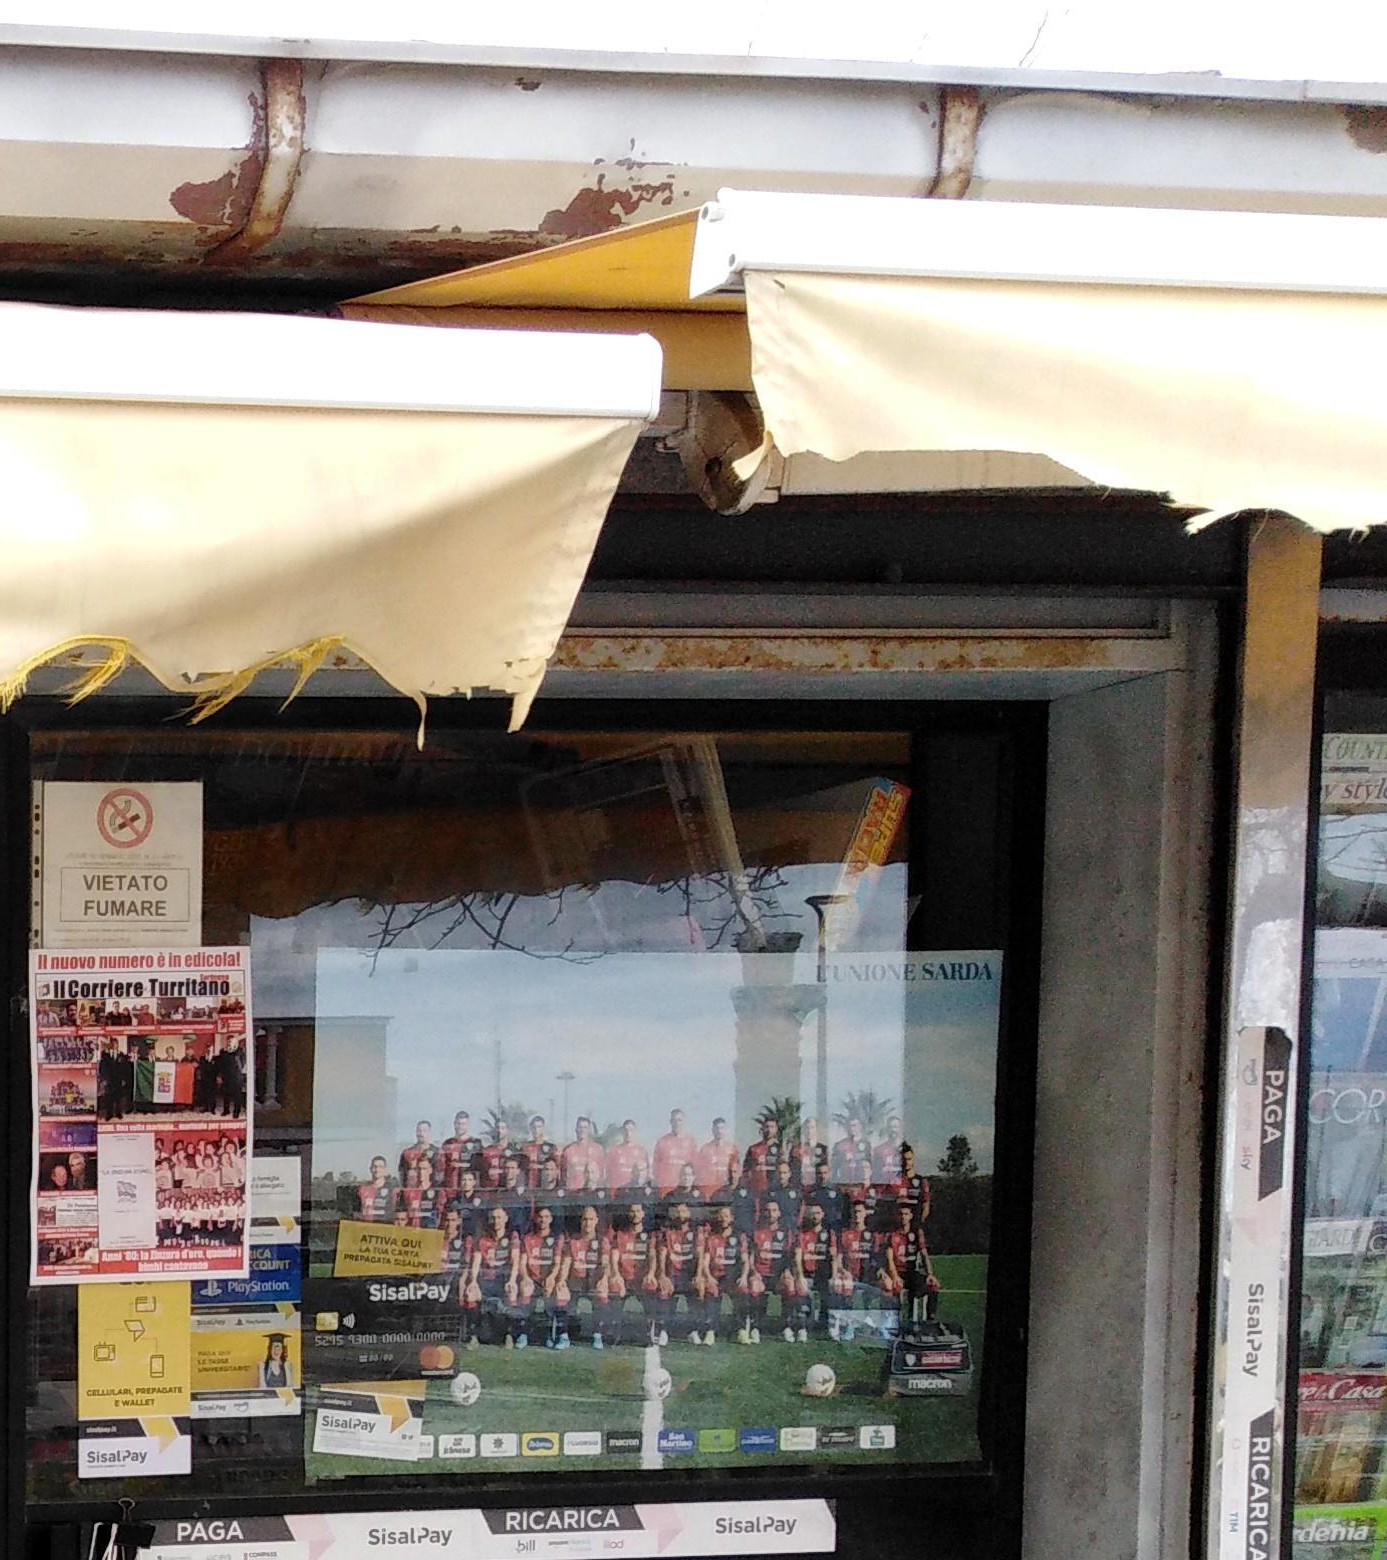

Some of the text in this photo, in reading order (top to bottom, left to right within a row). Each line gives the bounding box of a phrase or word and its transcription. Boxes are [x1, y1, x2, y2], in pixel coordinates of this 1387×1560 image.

[83, 874, 168, 892] VIETATO
[83, 900, 167, 917] FUMARE
[50, 955, 96, 970] nuovo
[99, 953, 154, 969] numero
[168, 953, 182, 968] in
[184, 951, 241, 968] edicola!
[921, 961, 993, 983] SARDA
[68, 979, 144, 998] Corriere
[149, 977, 230, 998] Turritano
[1264, 1069, 1284, 1145] PAGA
[359, 1233, 422, 1250] ATTIVA QUI
[227, 1279, 290, 1296] PlayStation
[369, 1282, 451, 1303] SisalPay
[1241, 1282, 1266, 1379] SisalPay
[135, 1386, 183, 1396] PREPAGATE
[121, 1398, 156, 1407] WALLET
[320, 1415, 377, 1434] SisalPay
[86, 1450, 148, 1466] SisalPay
[504, 1507, 621, 1532] RICARICA
[715, 1515, 798, 1537] SisalPay
[176, 1520, 245, 1543] PAGA
[367, 1526, 453, 1550] SisalPay
